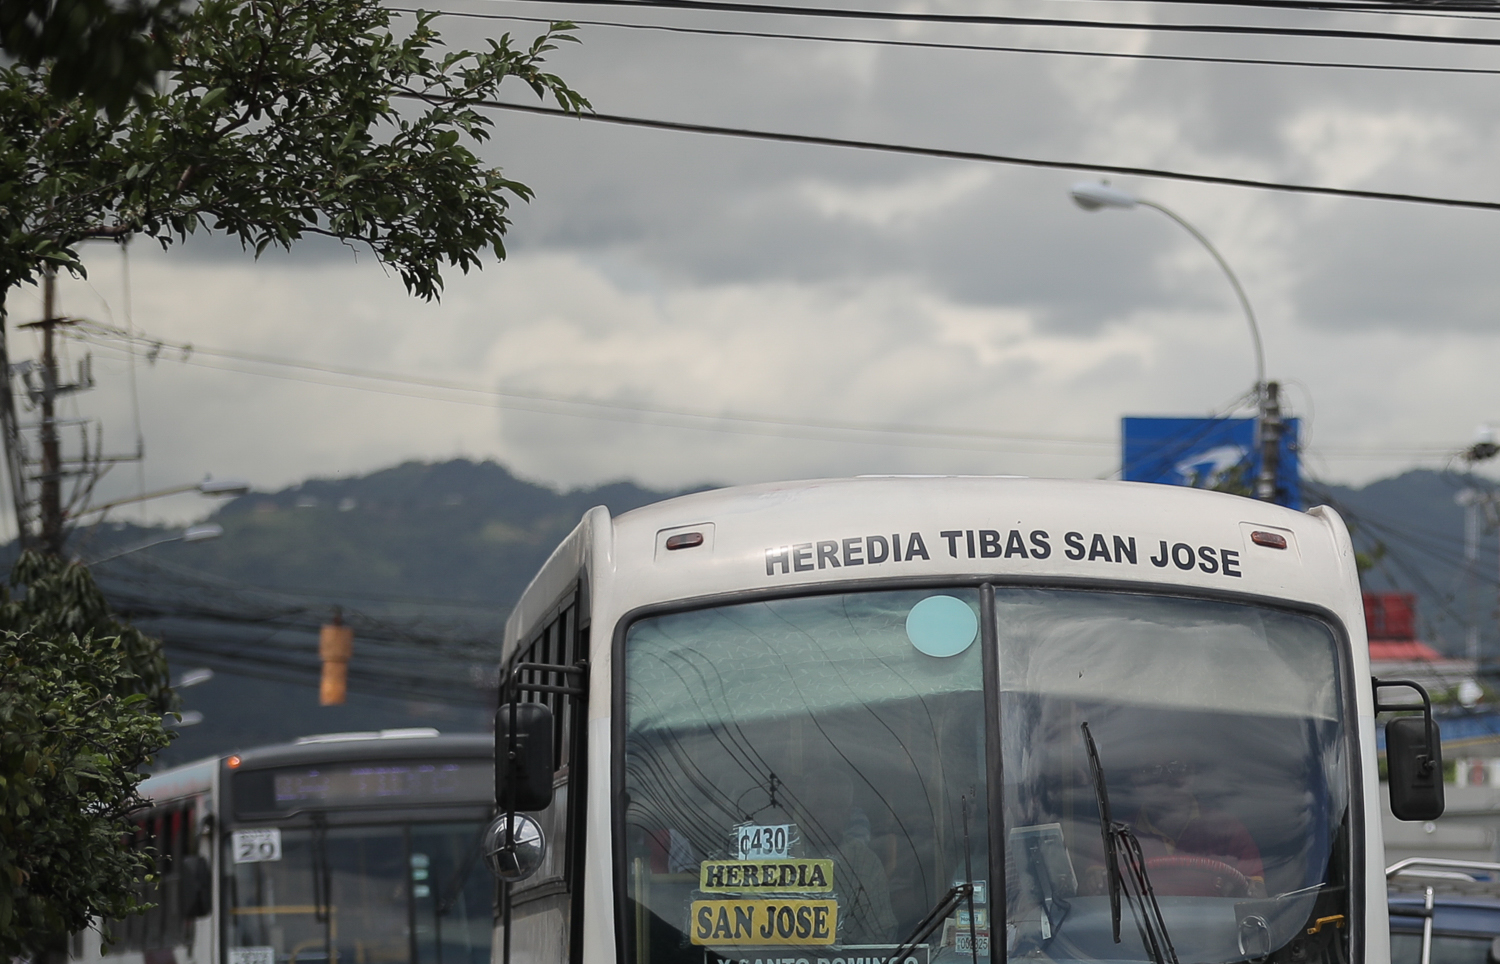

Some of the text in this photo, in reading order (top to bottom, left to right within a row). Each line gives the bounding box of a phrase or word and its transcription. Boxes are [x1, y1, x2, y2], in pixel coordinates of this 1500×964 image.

[765, 529, 1243, 578] HEREDIA TIBAS SAN JOSE
[240, 842, 275, 861] 20
[705, 864, 827, 888] HEREDIA
[697, 905, 829, 939] SAN JOSE
